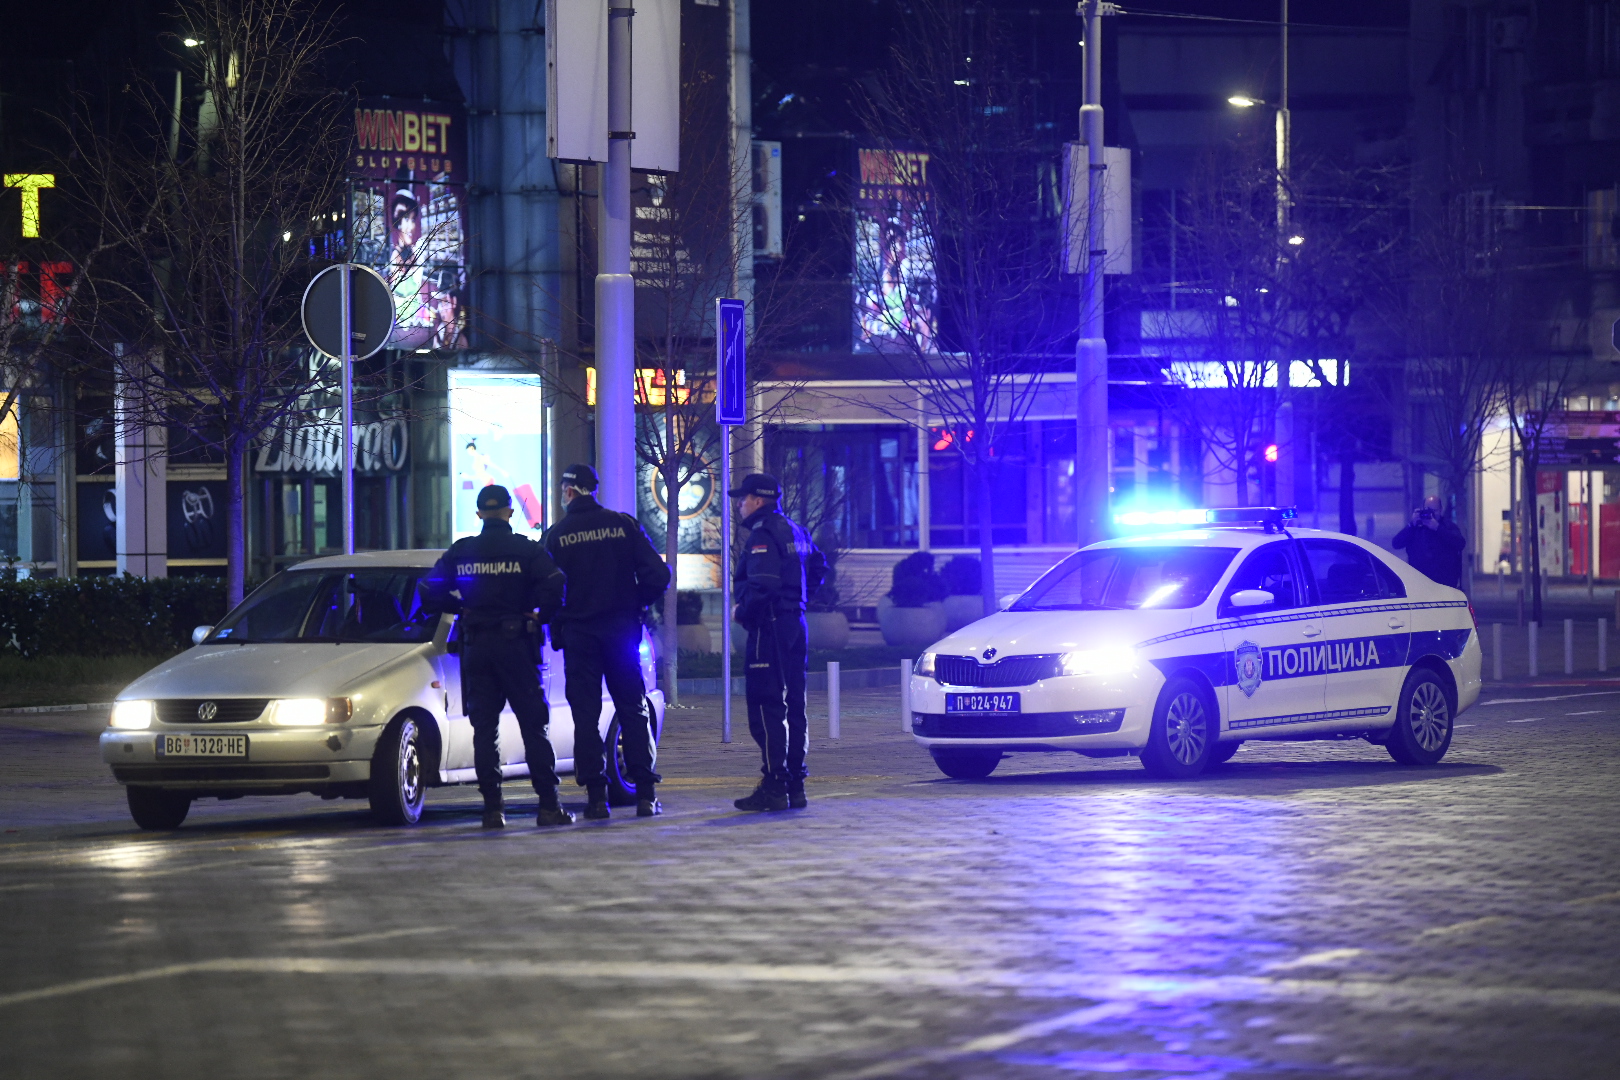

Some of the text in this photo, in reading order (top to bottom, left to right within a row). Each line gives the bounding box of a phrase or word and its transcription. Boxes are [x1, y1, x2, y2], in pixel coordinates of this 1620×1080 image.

[354, 108, 451, 154] WINBET
[858, 148, 929, 186] WINBET
[3, 173, 56, 238] T
[559, 527, 626, 547] ПОЛИЦИЈА
[456, 561, 522, 576] ПОЛИЦИЈА
[1268, 640, 1380, 676] ПОЛИЦИЈА
[166, 738, 182, 753] BG
